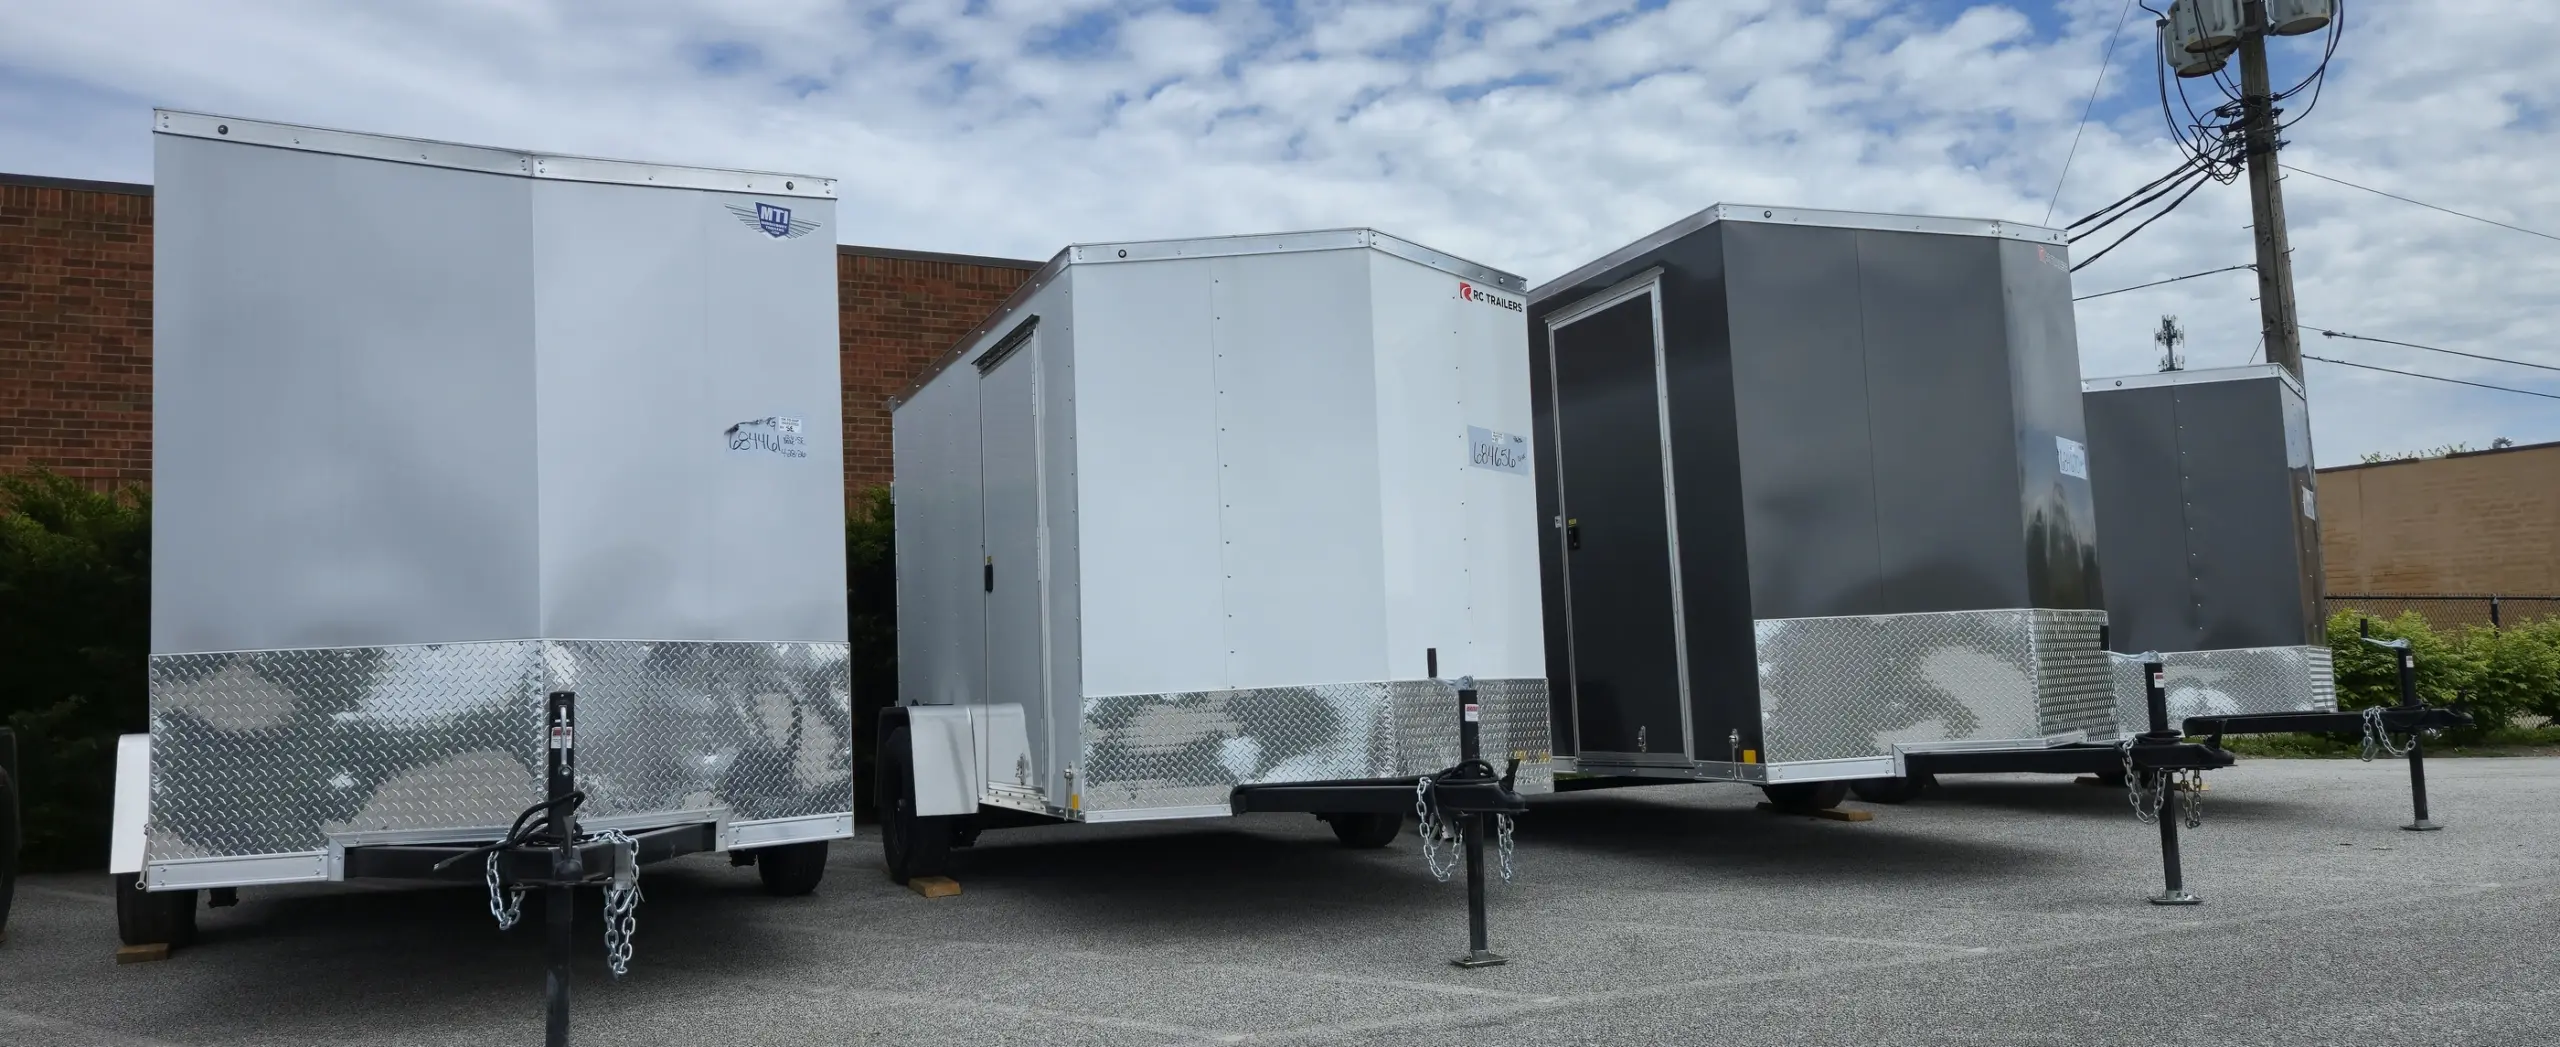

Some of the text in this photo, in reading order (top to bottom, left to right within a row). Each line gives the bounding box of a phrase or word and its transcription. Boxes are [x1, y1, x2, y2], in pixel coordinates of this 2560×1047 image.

[761, 206, 789, 224] MTI
[1473, 289, 1523, 313] RC TRAILERS
[728, 431, 781, 453] 684461
[1473, 441, 1516, 468] 684656
